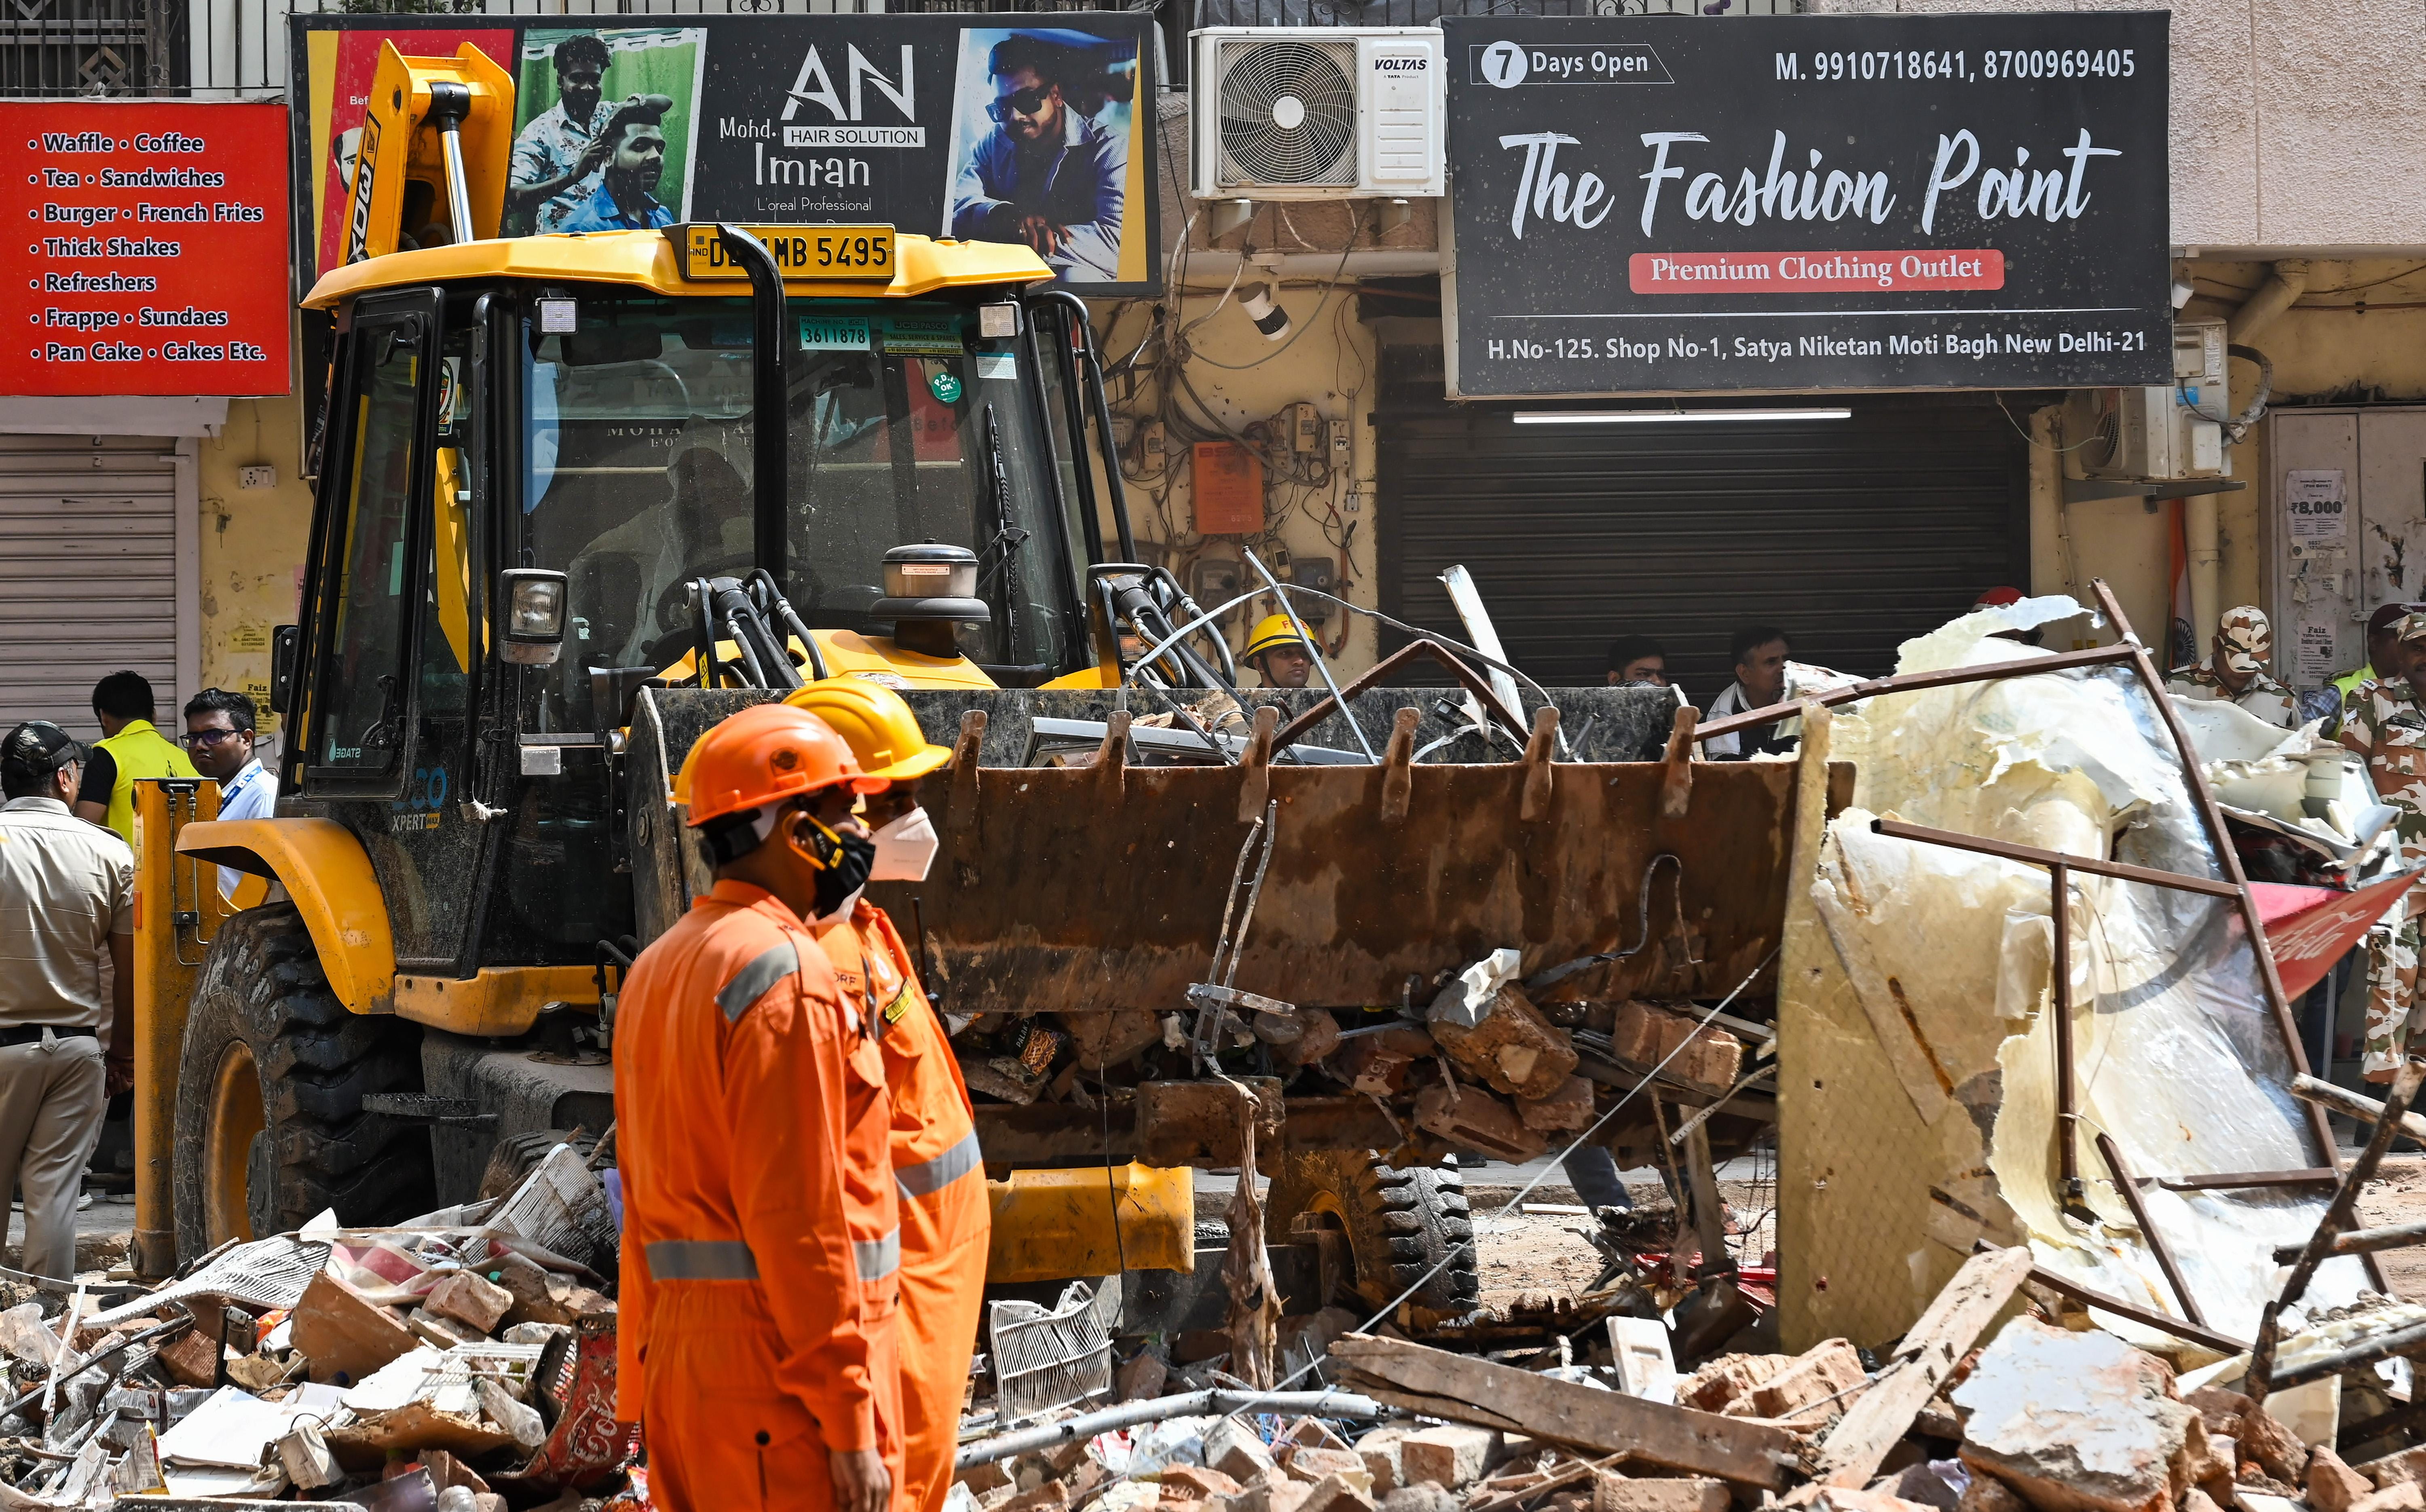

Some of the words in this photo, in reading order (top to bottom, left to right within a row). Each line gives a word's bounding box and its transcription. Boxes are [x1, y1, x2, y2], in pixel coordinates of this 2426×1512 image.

[1375, 59, 1427, 70] VOLTAS
[1496, 50, 1512, 79] 7
[1533, 52, 1583, 78] Days
[1591, 51, 1647, 77] Open
[1776, 53, 1805, 80] M.
[1815, 51, 1974, 82] 9910718641,
[1985, 50, 2134, 78] 8700969405
[781, 43, 914, 123] AN
[350, 96, 369, 106] Bef
[721, 117, 776, 138] Mohd.
[792, 130, 830, 142] HAIR
[835, 130, 917, 143] SOLUTION
[44, 134, 112, 151] Waffle
[135, 134, 203, 151] Coffee
[756, 142, 869, 187] Imran
[44, 170, 78, 186] Tea
[102, 169, 222, 186] Sandwiches
[1499, 131, 1615, 240] The
[1639, 129, 1896, 237] Fashion
[1922, 128, 2122, 235] Point
[758, 197, 796, 211] L'oreal
[801, 196, 871, 211] Professional
[46, 205, 116, 226] Burger
[139, 203, 206, 220] French
[216, 204, 262, 221] Fries
[45, 239, 101, 256] Thick
[108, 238, 178, 255] Shakes
[693, 248, 708, 256] IND
[817, 237, 887, 266] 5495
[1651, 258, 1771, 280] Premium
[1779, 256, 1892, 286] Clothing
[1901, 255, 1982, 277] Outlet
[47, 273, 154, 291] Refreshers
[47, 309, 117, 330] Frappe
[141, 308, 226, 325] Sundaes
[804, 328, 866, 344] 3611878
[48, 344, 84, 360] Pan
[92, 342, 141, 360] Cake
[164, 342, 222, 359] Cakes
[230, 343, 264, 359] Etc.
[1489, 339, 1599, 359] H.No-125.
[1606, 338, 1660, 363] Shop
[1668, 338, 1726, 360] No-1,
[1735, 338, 1791, 362] Satya
[1800, 336, 1881, 356] Niketan
[1890, 334, 1938, 354] Moti
[1946, 334, 1997, 359] Bagh
[2006, 334, 2051, 353] New
[2059, 332, 2143, 352] Delhi-21
[940, 383, 953, 391] OK
[2290, 501, 2342, 515] ₹8,000
[391, 813, 426, 832] XPERT
[1016, 1024, 1028, 1048] PALAK
